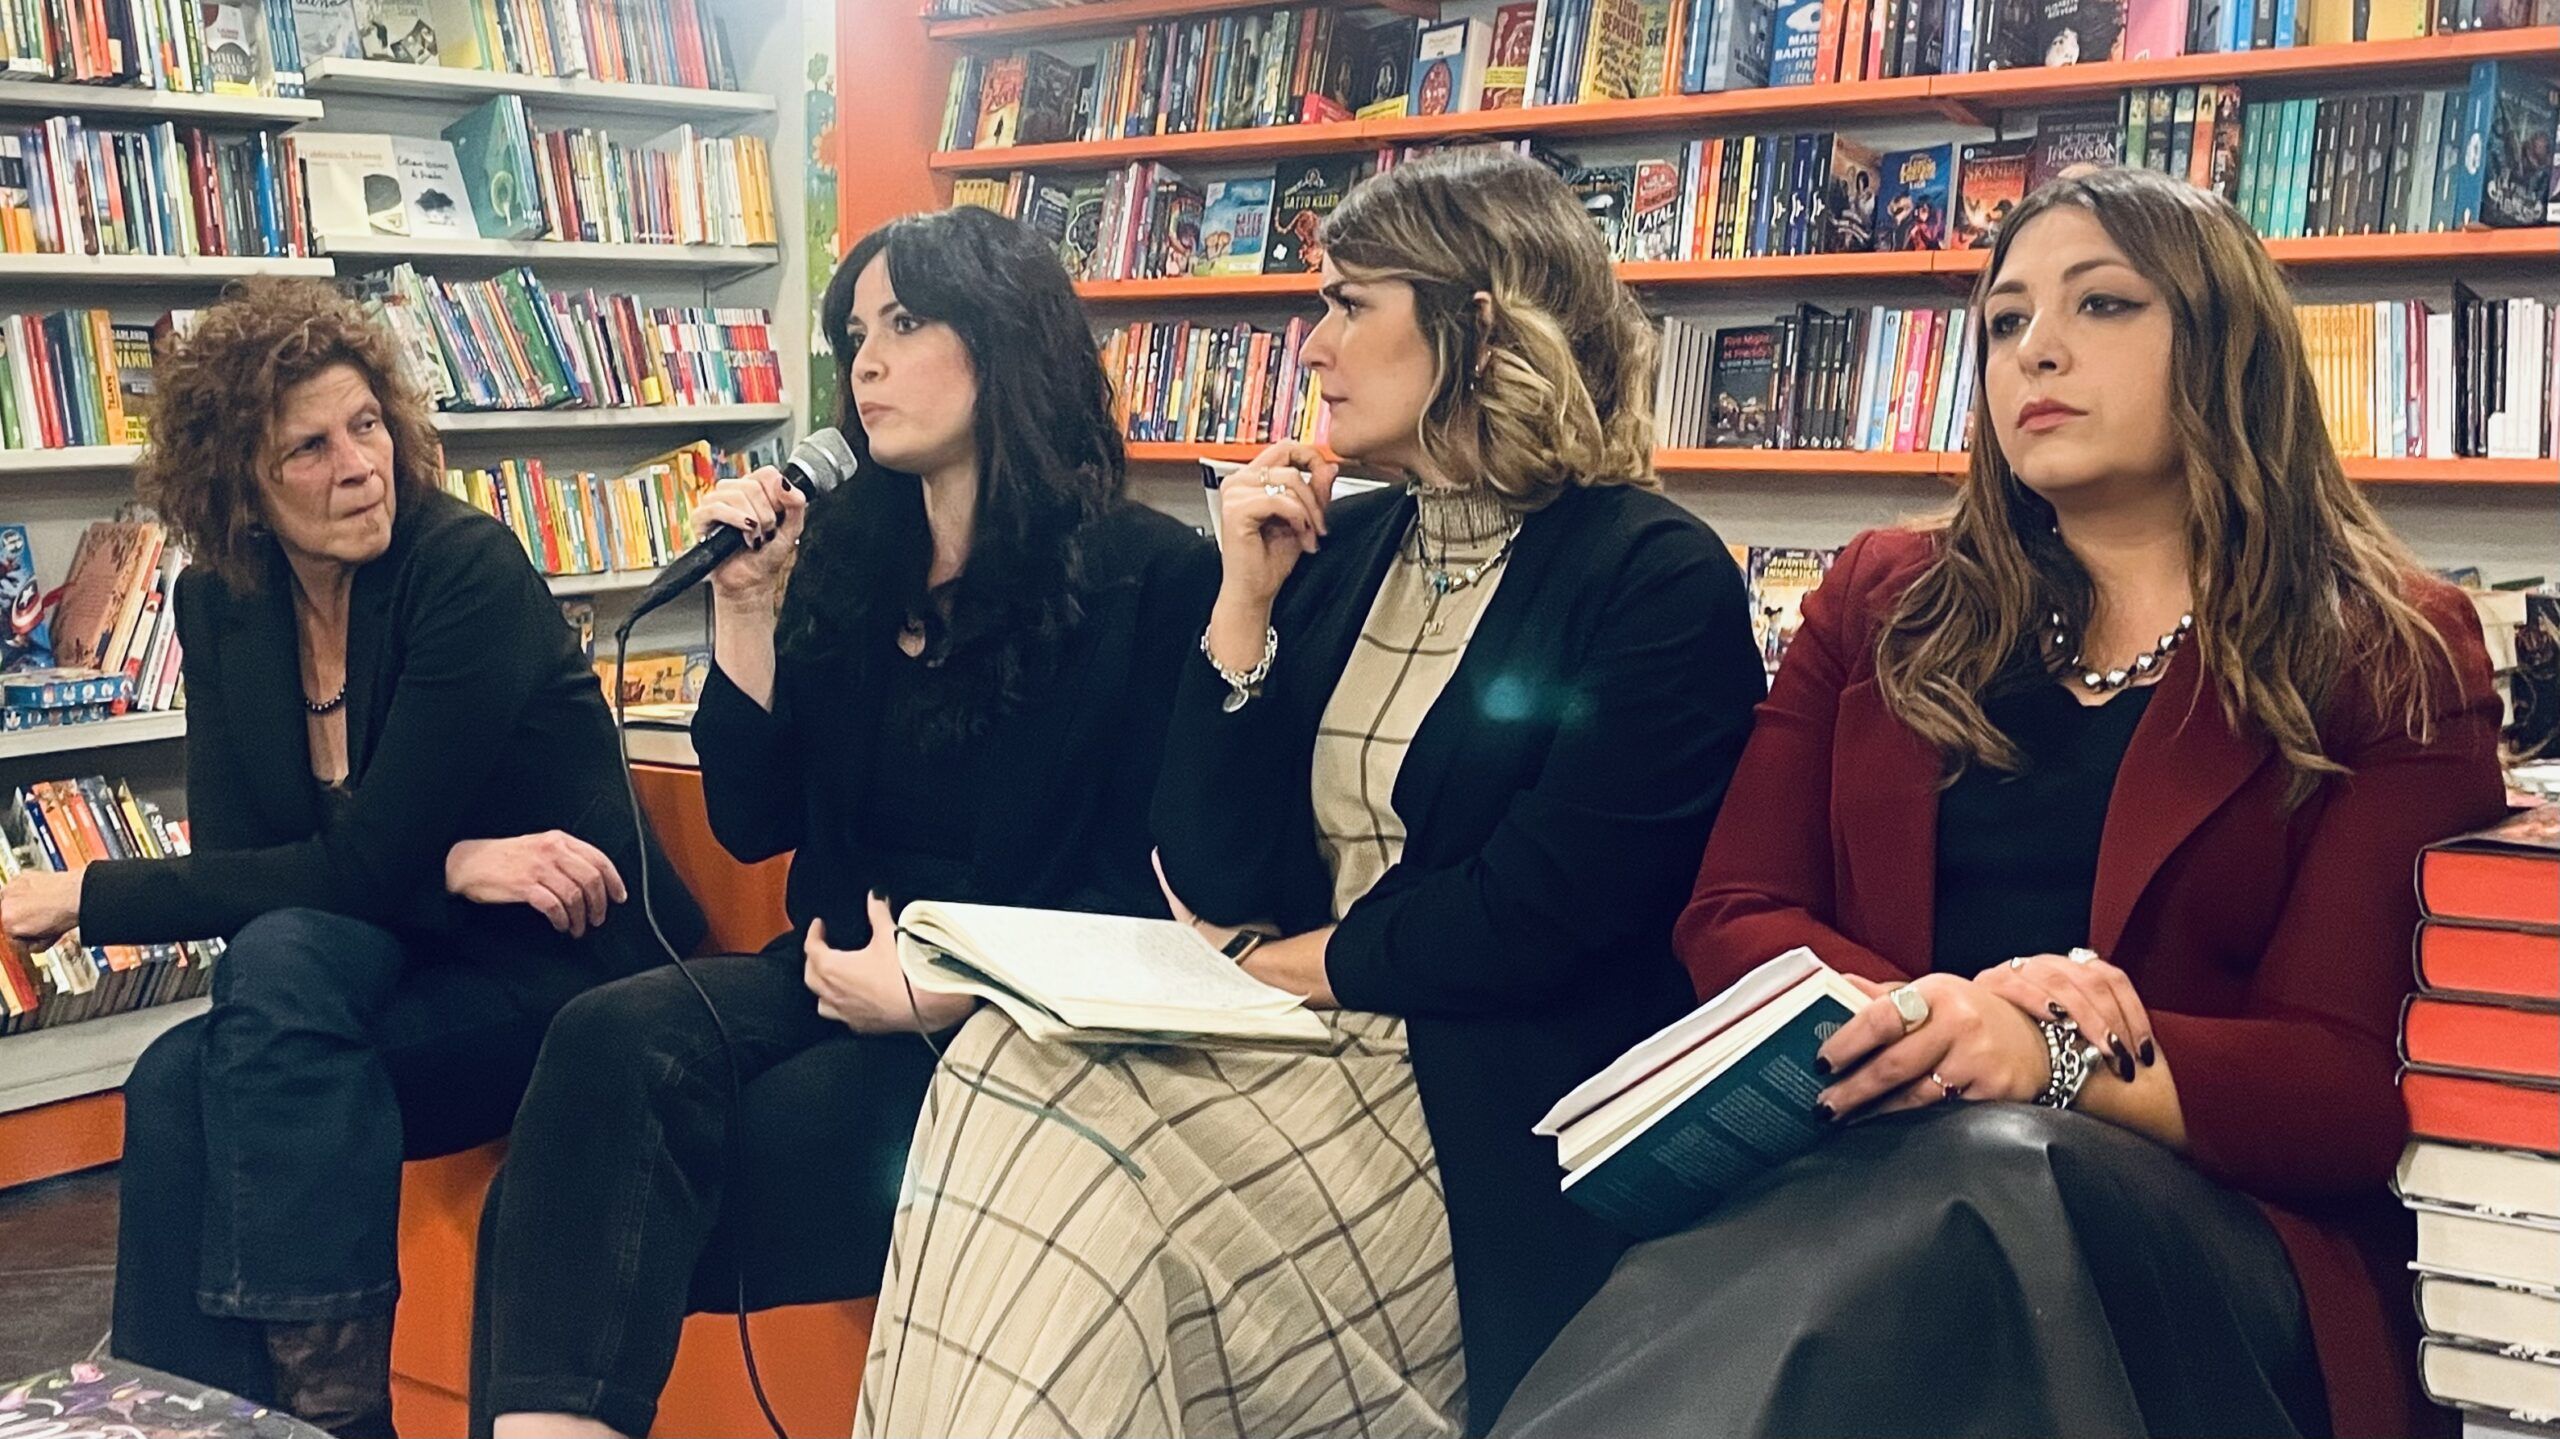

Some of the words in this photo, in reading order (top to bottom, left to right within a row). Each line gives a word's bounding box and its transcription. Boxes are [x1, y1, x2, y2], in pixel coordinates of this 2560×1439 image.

[1788, 33, 1818, 46] MAR
[1775, 47, 1817, 61] BARTO
[2046, 143, 2115, 165] JACKSON
[1284, 195, 1311, 209] GATTO
[115, 351, 153, 368] VANNI
